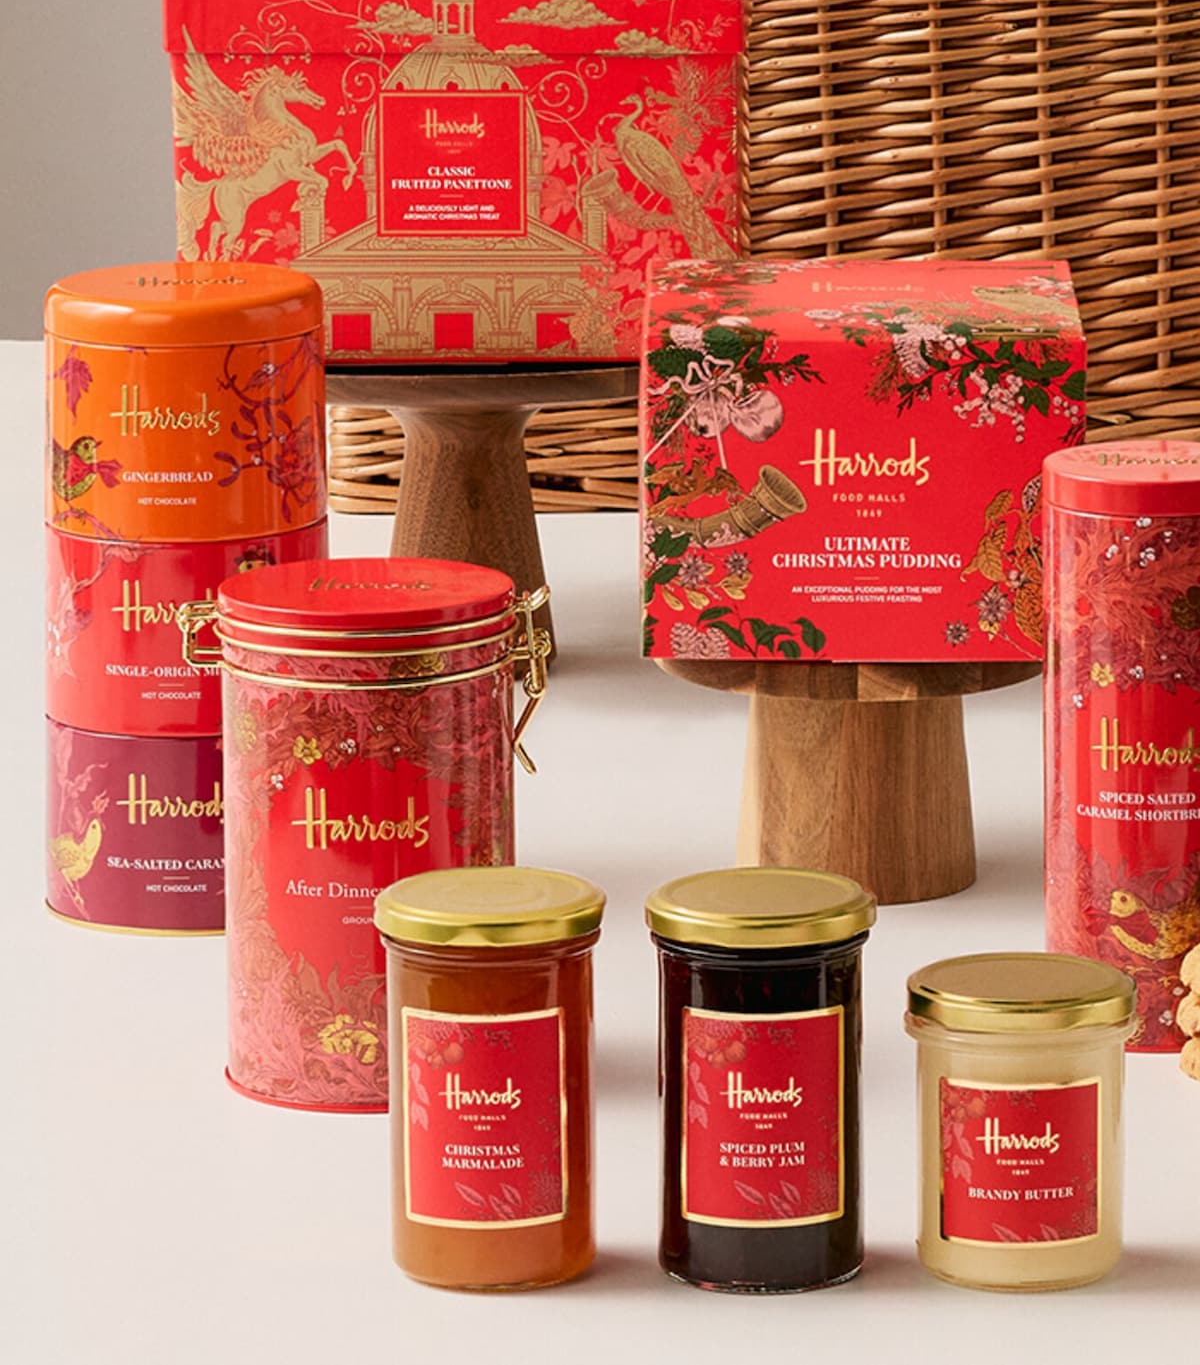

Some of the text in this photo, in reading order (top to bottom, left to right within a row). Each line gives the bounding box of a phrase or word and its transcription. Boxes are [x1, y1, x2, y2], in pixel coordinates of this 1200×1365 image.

[419, 108, 485, 139] Harrods
[427, 166, 475, 176] CLASSIC
[391, 178, 512, 189] FRUITED PANETTONE
[415, 204, 457, 212] DELICIOUSLY
[459, 204, 477, 212] LIGHT
[480, 204, 495, 212] AND
[110, 384, 220, 436] Harrods
[798, 428, 930, 486] Harrods
[122, 471, 213, 483] GINGERBREAD
[138, 497, 197, 505] HOT CHOCOLATE
[833, 493, 906, 503] FOOD HALLS
[856, 509, 882, 518] 1849
[824, 537, 911, 551] ULTIMATE
[772, 553, 962, 569] CHRISTMAS PUDDING
[792, 586, 943, 594] AN EXCEPTIONAL PUDDING FOR THE MOST
[811, 595, 922, 603] LUXURIOUS FESTIVE FEASTING
[111, 580, 213, 632] Harr
[105, 664, 200, 677] SINGLE-ORIGIN
[141, 692, 201, 700] HOT CHOCOLATE
[1099, 791, 1196, 804] SPICED SALTED
[291, 787, 429, 850] Harrods
[1077, 804, 1131, 820] CARAMEL
[107, 856, 182, 871] SEA-SALTED
[163, 884, 208, 892] CHOCOLATE
[285, 879, 323, 897] After
[438, 1072, 521, 1110] Harrods
[719, 1071, 802, 1109] Harrods
[976, 1117, 1060, 1155] Harrods
[445, 1143, 520, 1157] CHRISTMAS
[719, 1142, 805, 1154] SPICED PLUM
[442, 1157, 524, 1170] MARMALADE
[719, 1155, 805, 1167] & BERRY JAM
[968, 1187, 1074, 1200] BRANDY BUTTER
